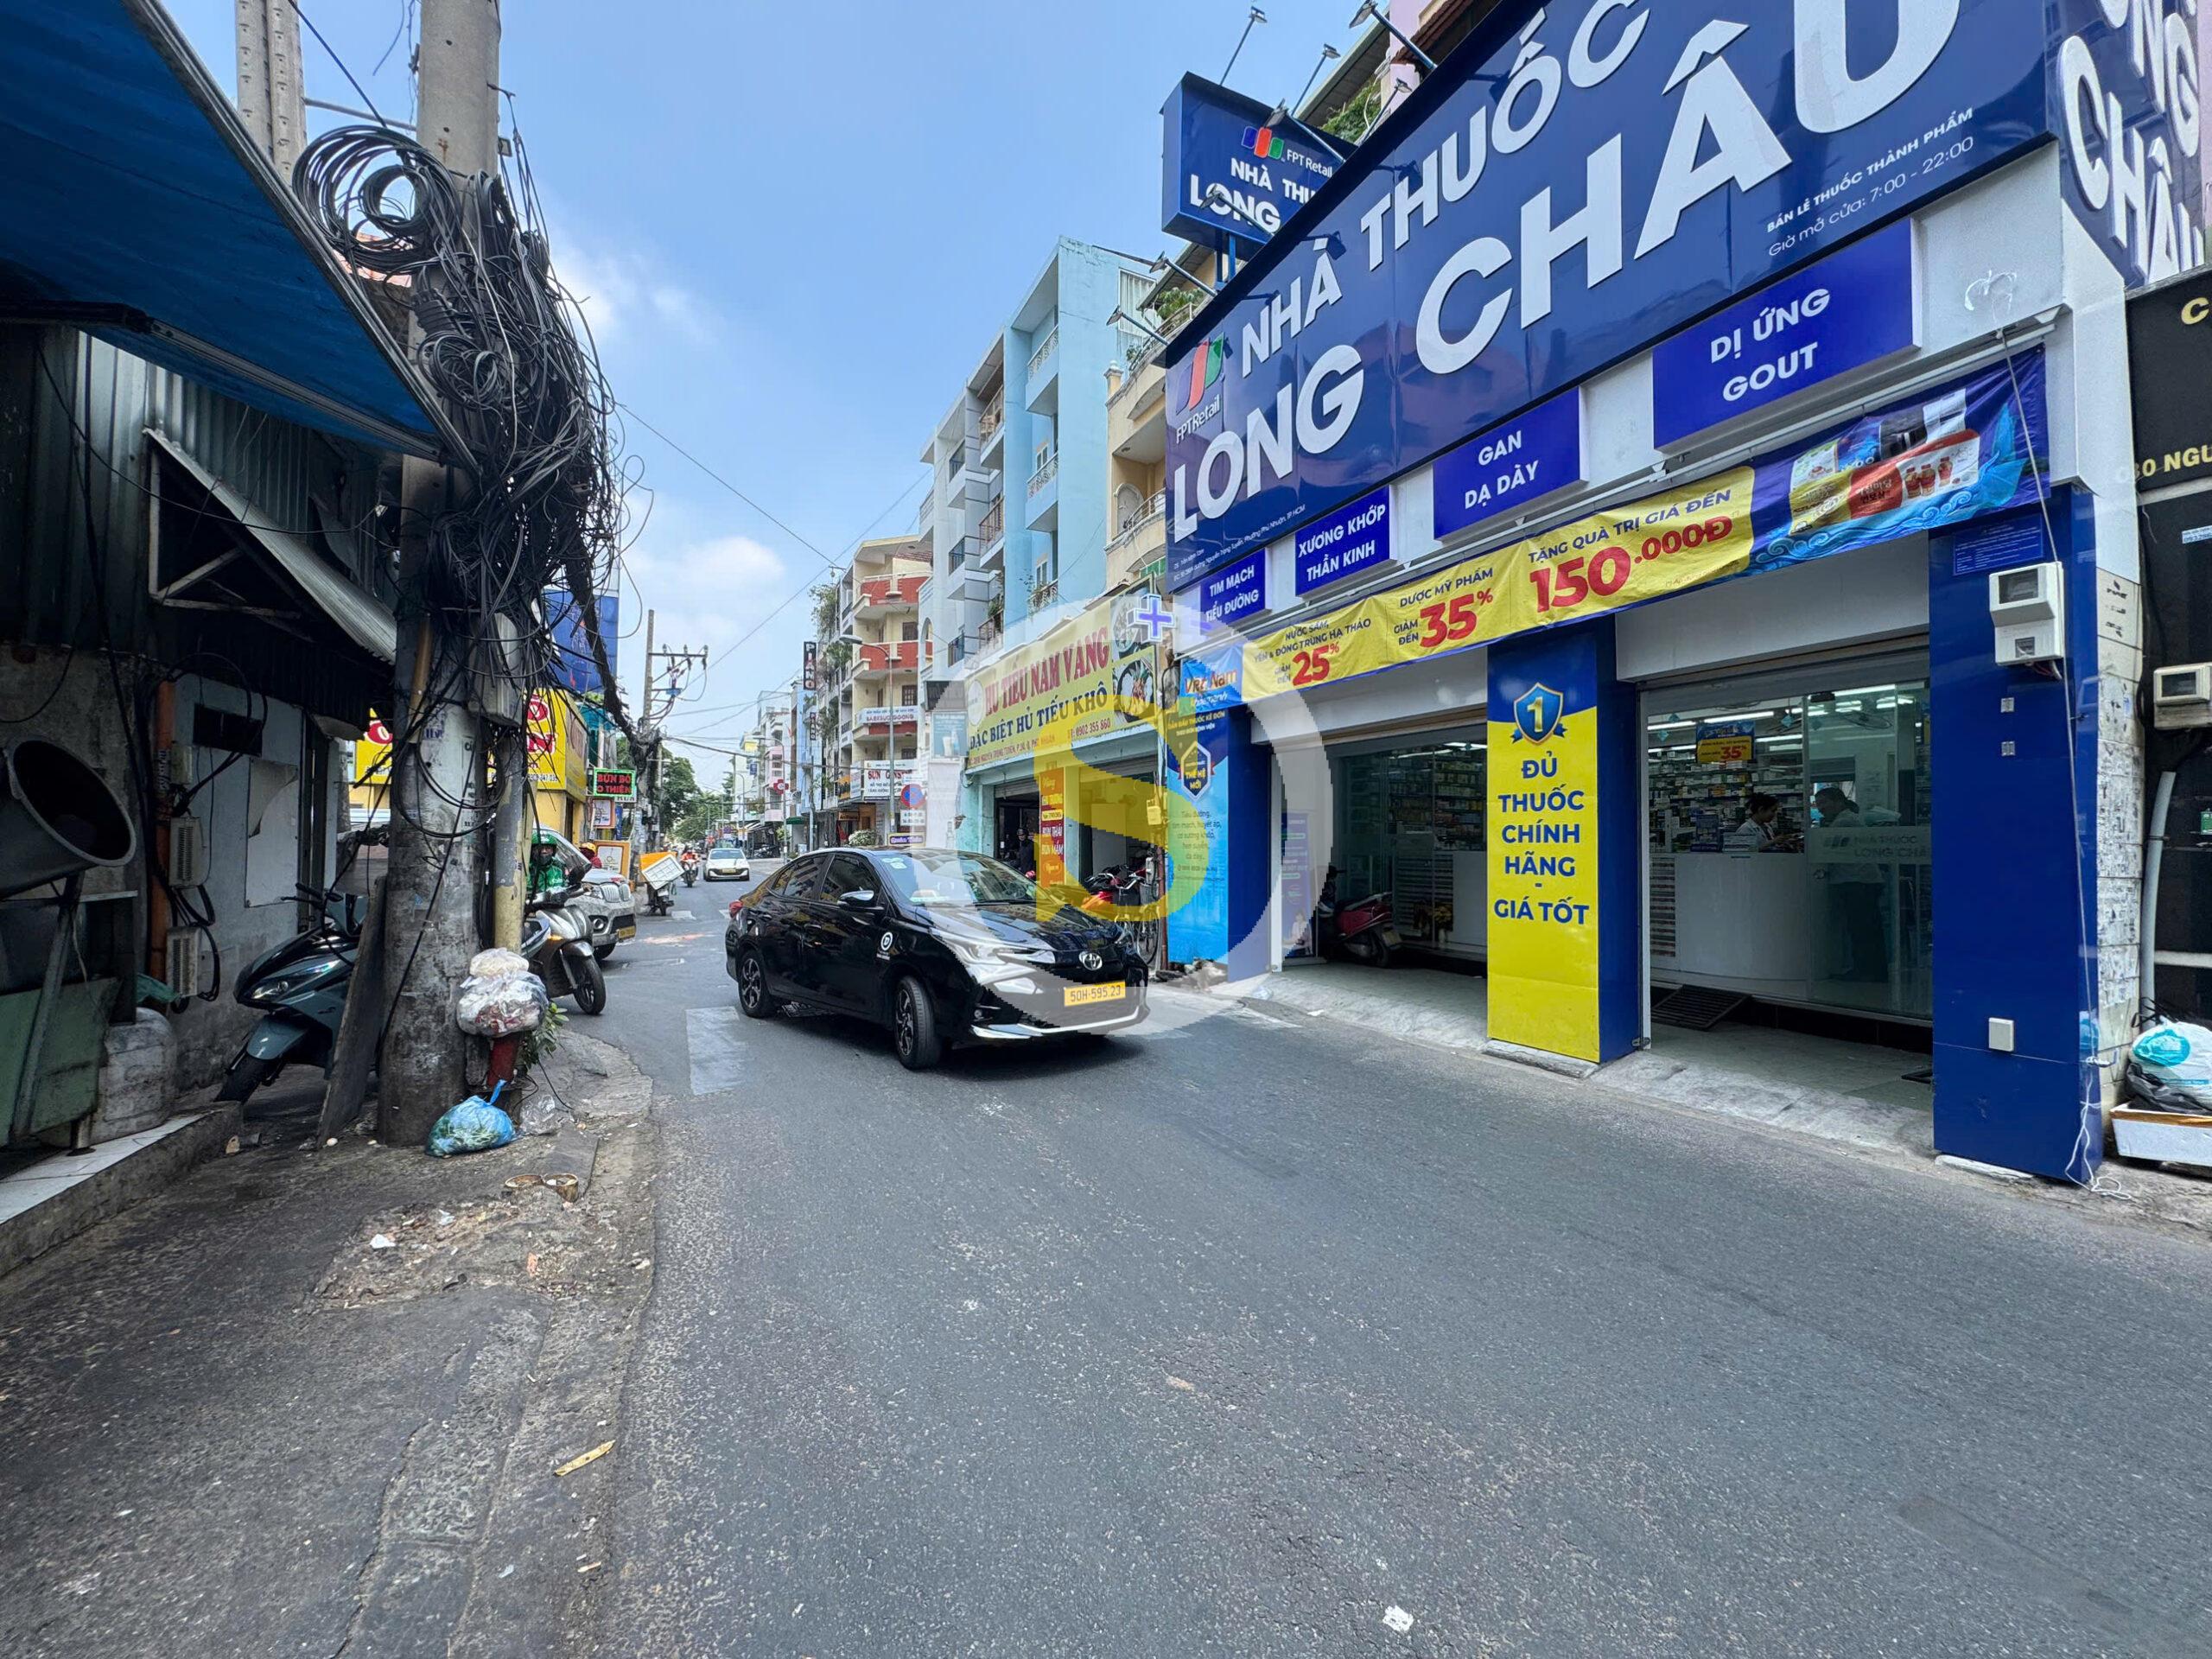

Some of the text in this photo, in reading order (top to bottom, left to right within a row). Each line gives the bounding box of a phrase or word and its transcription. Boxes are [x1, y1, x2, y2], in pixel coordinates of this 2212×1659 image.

[1230, 158, 1273, 192] NHÀ
[1287, 149, 1332, 178] FPT Retail
[1767, 107, 1973, 232] BÁN LẺ THUỐC THÀNH PHẨM
[1190, 175, 1281, 234] LONG
[1242, 0, 1649, 378] NHÀ THUỐC
[1769, 234, 1796, 256] Giờ
[1799, 217, 1826, 241] mở
[1828, 198, 1866, 225] cửa:
[1870, 174, 1906, 202] 7:00
[1923, 137, 1974, 174] 22:00
[1173, 0, 1961, 544] LONG CHÂU
[1711, 289, 1831, 364] DỊ ỨNG
[1723, 341, 1819, 402] GOUT
[1176, 393, 1220, 444] FPT Retail
[1478, 429, 1522, 466] GAN
[1465, 460, 1539, 510] DẠ DÀY
[1298, 504, 1386, 558] XƯƠNG KHỚP
[1528, 488, 1732, 563] TẶNG QUÀ TRỊ GIÁ ĐẾN
[1210, 564, 1255, 598] TIM MẠCH
[1306, 539, 1376, 582] THẦN KINH
[1529, 515, 1733, 613] 150.000Đ
[1205, 588, 1260, 622] TIỂU ĐƯỜNG
[1400, 567, 1494, 608] DƯỢC MỸ PHẨM
[1274, 642, 1299, 657] ĐÔNG
[1299, 632, 1328, 649] TRÙNG
[1328, 627, 1343, 641] HẠ
[1344, 616, 1372, 635] THẢO
[1285, 623, 1308, 641] NƯỚC
[1394, 618, 1419, 634] GIẢM
[1398, 588, 1494, 648] ĐẾN 35%
[804, 643, 816, 690] PIANO
[1030, 651, 1061, 697] NAM
[1062, 626, 1110, 683] VANG
[969, 728, 988, 752] ĐẶC
[989, 718, 1014, 744] BIỆT
[1016, 705, 1033, 734] HỦ
[1036, 694, 1070, 728] TIẾU
[1072, 680, 1108, 717] KHÔ
[1526, 695, 1544, 734] 1
[597, 772, 632, 785] BÚN BÒ
[1521, 750, 1558, 779] ĐỦ
[1497, 783, 1585, 813] THUỐC
[1501, 818, 1580, 843] CHÍNH
[1504, 851, 1576, 877] HÃNG
[1493, 895, 1590, 925] GIÁ TỐT
